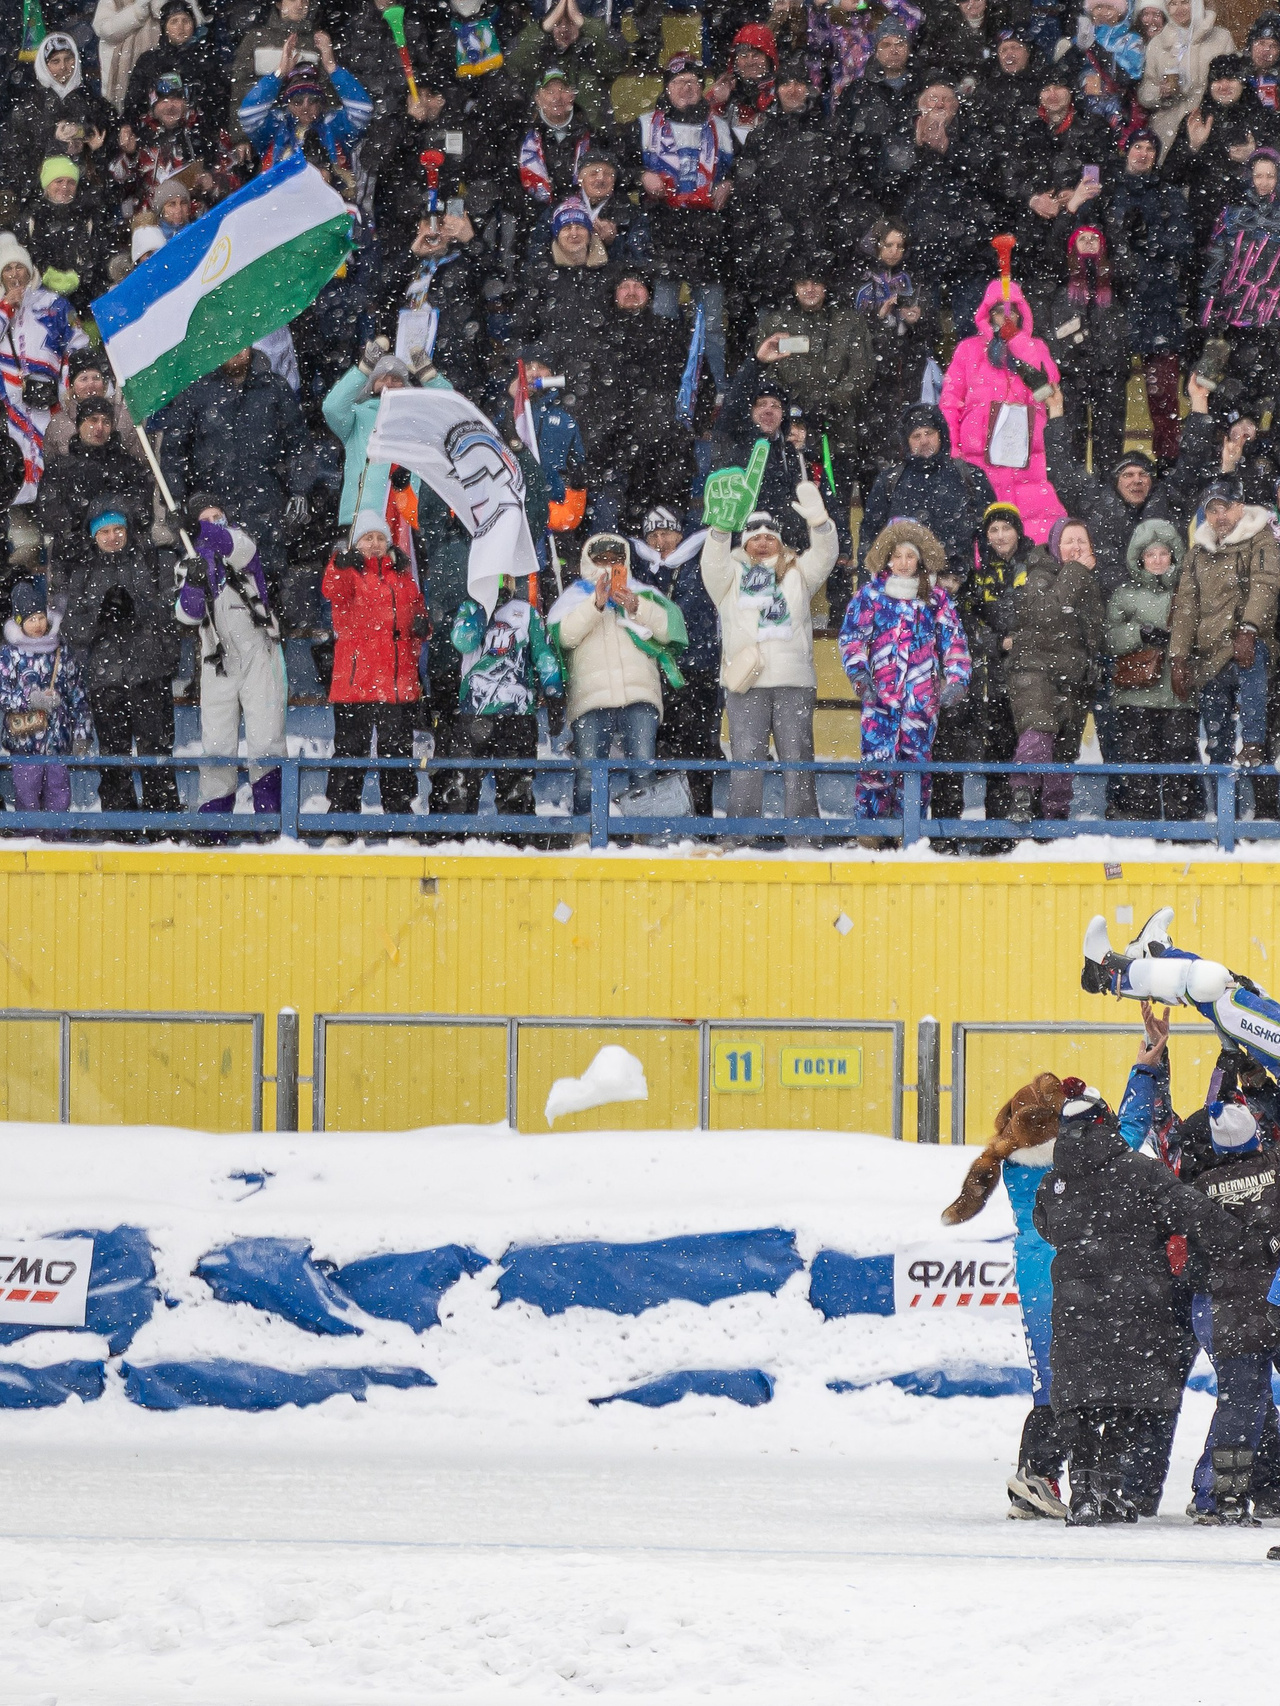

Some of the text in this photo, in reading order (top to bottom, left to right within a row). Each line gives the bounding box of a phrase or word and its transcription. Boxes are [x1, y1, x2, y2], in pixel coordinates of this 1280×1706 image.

[726, 1051, 752, 1082] 11
[794, 1058, 846, 1075] ГОСТИ
[1219, 1175, 1259, 1194] GERMAN
[1216, 1185, 1264, 1207] Racing
